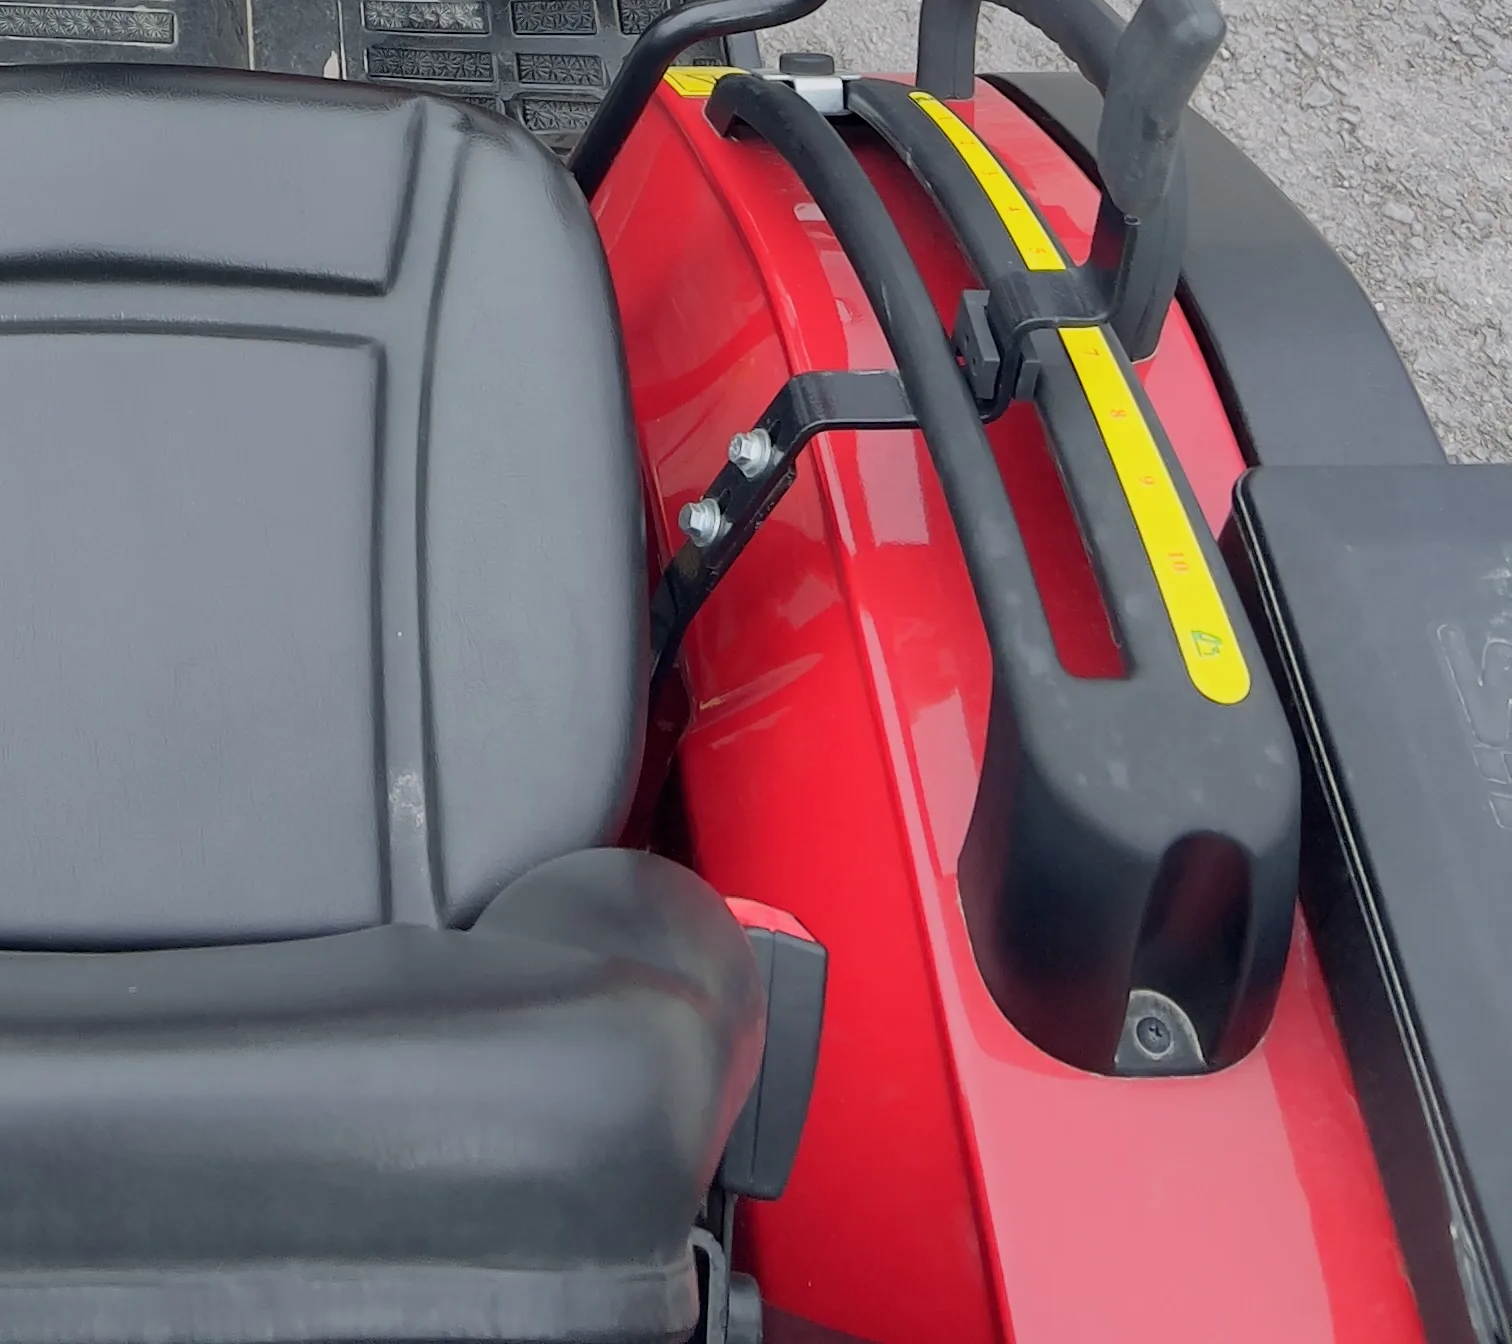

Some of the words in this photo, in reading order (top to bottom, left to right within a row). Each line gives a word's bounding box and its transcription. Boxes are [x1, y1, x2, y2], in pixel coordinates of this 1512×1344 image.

[1109, 408, 1126, 418] 8
[1138, 475, 1155, 485] 9
[1167, 550, 1189, 572] 10
